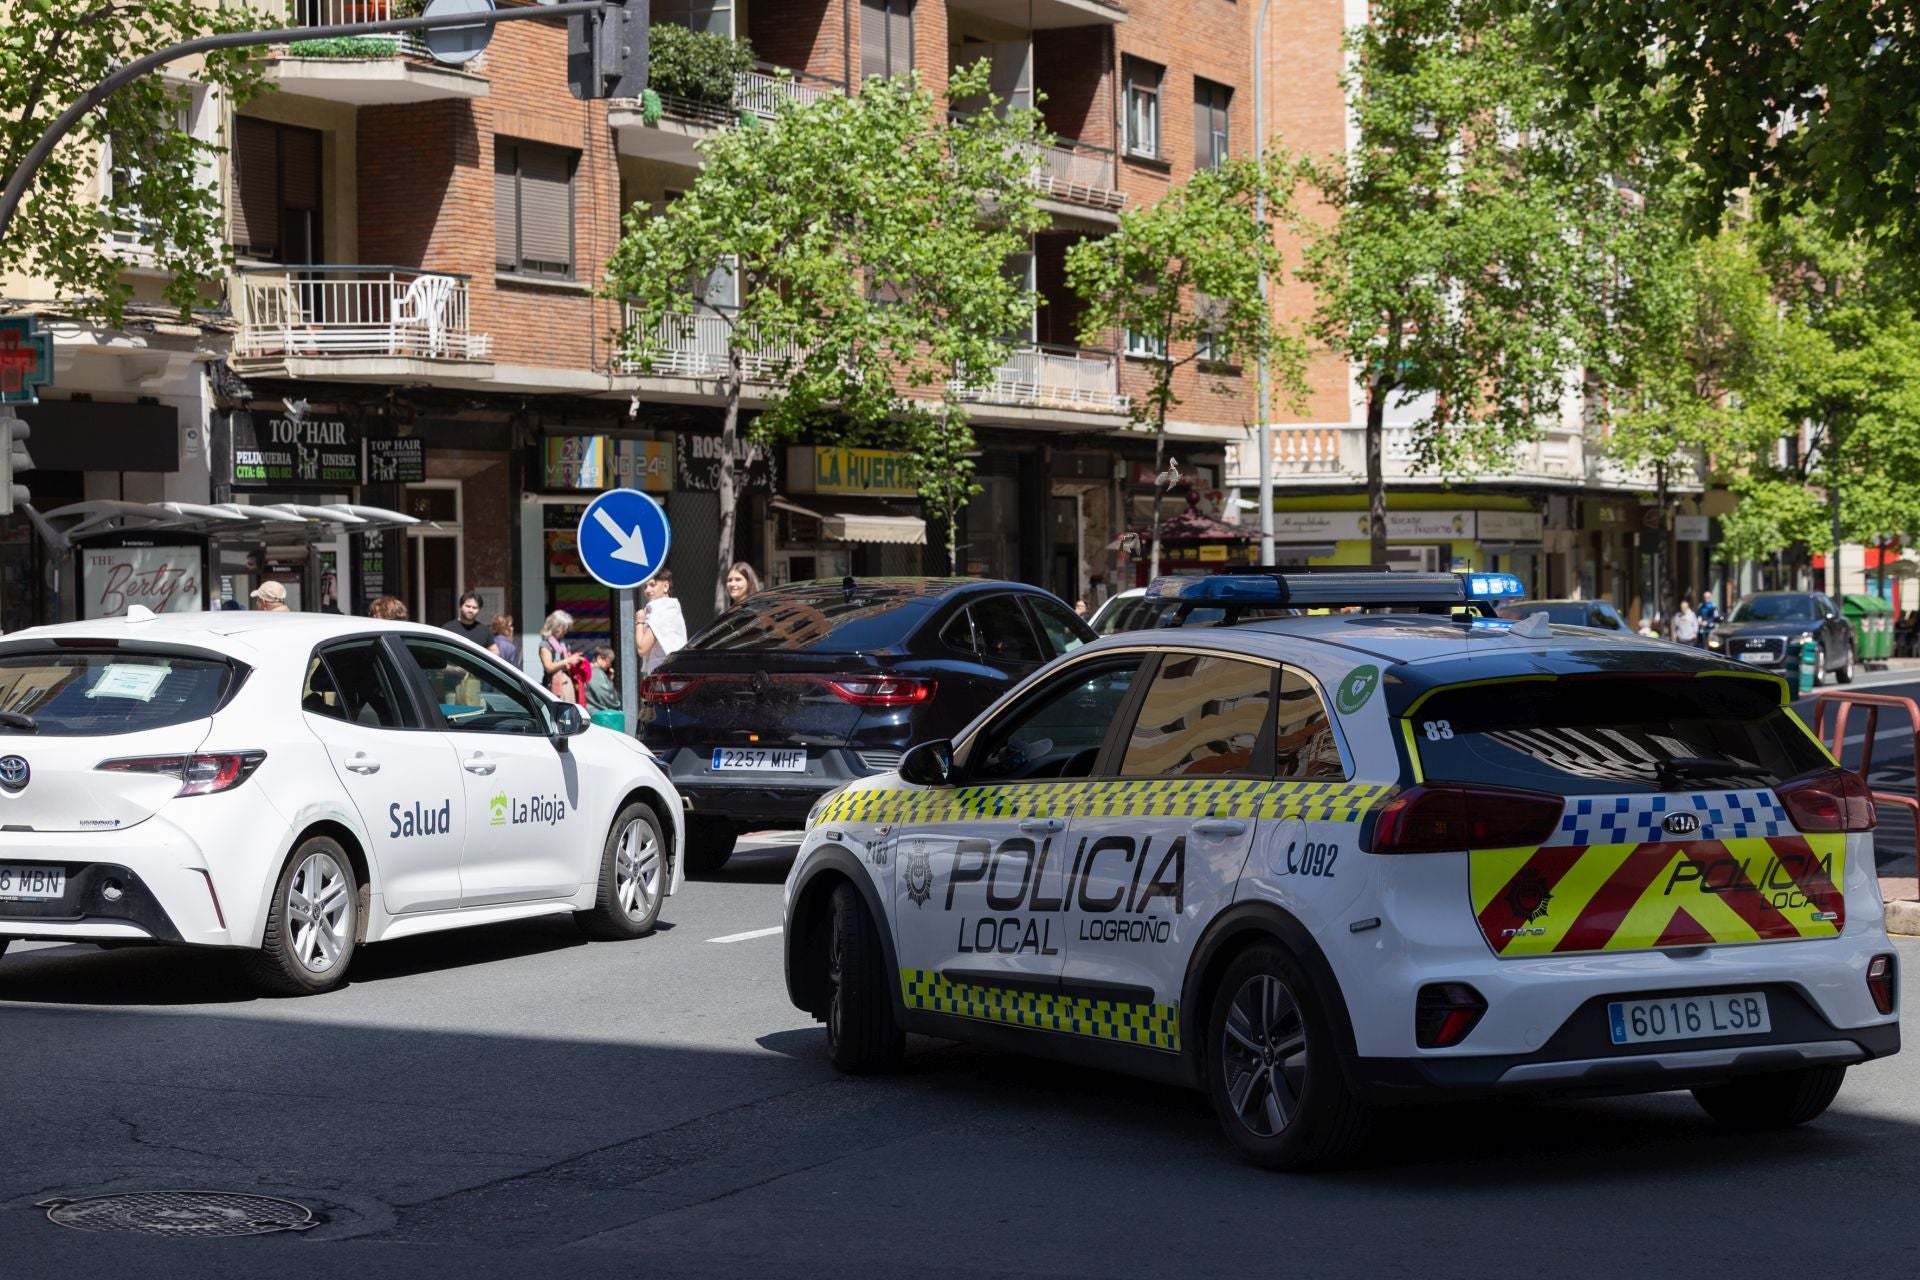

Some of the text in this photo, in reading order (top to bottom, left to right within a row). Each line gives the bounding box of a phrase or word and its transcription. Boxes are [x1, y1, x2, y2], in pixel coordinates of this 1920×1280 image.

[269, 419, 347, 446] TOP HAIR
[371, 440, 422, 451] TOP HAIR
[236, 450, 292, 465] PELUQUERIA
[321, 453, 356, 466] UNISEX
[692, 435, 764, 461] ROSANA
[236, 466, 255, 479] CITA:
[817, 453, 840, 486] LA
[90, 555, 114, 566] THE
[1423, 719, 1455, 741] 83
[723, 751, 766, 768] 2257
[770, 751, 803, 769] MHF
[389, 798, 451, 839] Salud
[512, 793, 565, 826] La Rioja
[1668, 816, 1696, 831] KIA
[1300, 842, 1339, 878] 092
[0, 869, 60, 893] 6 MBN
[944, 835, 1188, 914] POLICIA
[1663, 852, 1833, 897] POLICIA
[1759, 888, 1831, 911] LOCAL
[957, 917, 1059, 955] LOCAL
[1079, 915, 1171, 944] LOGROÑO
[1631, 1001, 1702, 1037] 6016
[1709, 997, 1761, 1031] LSB
